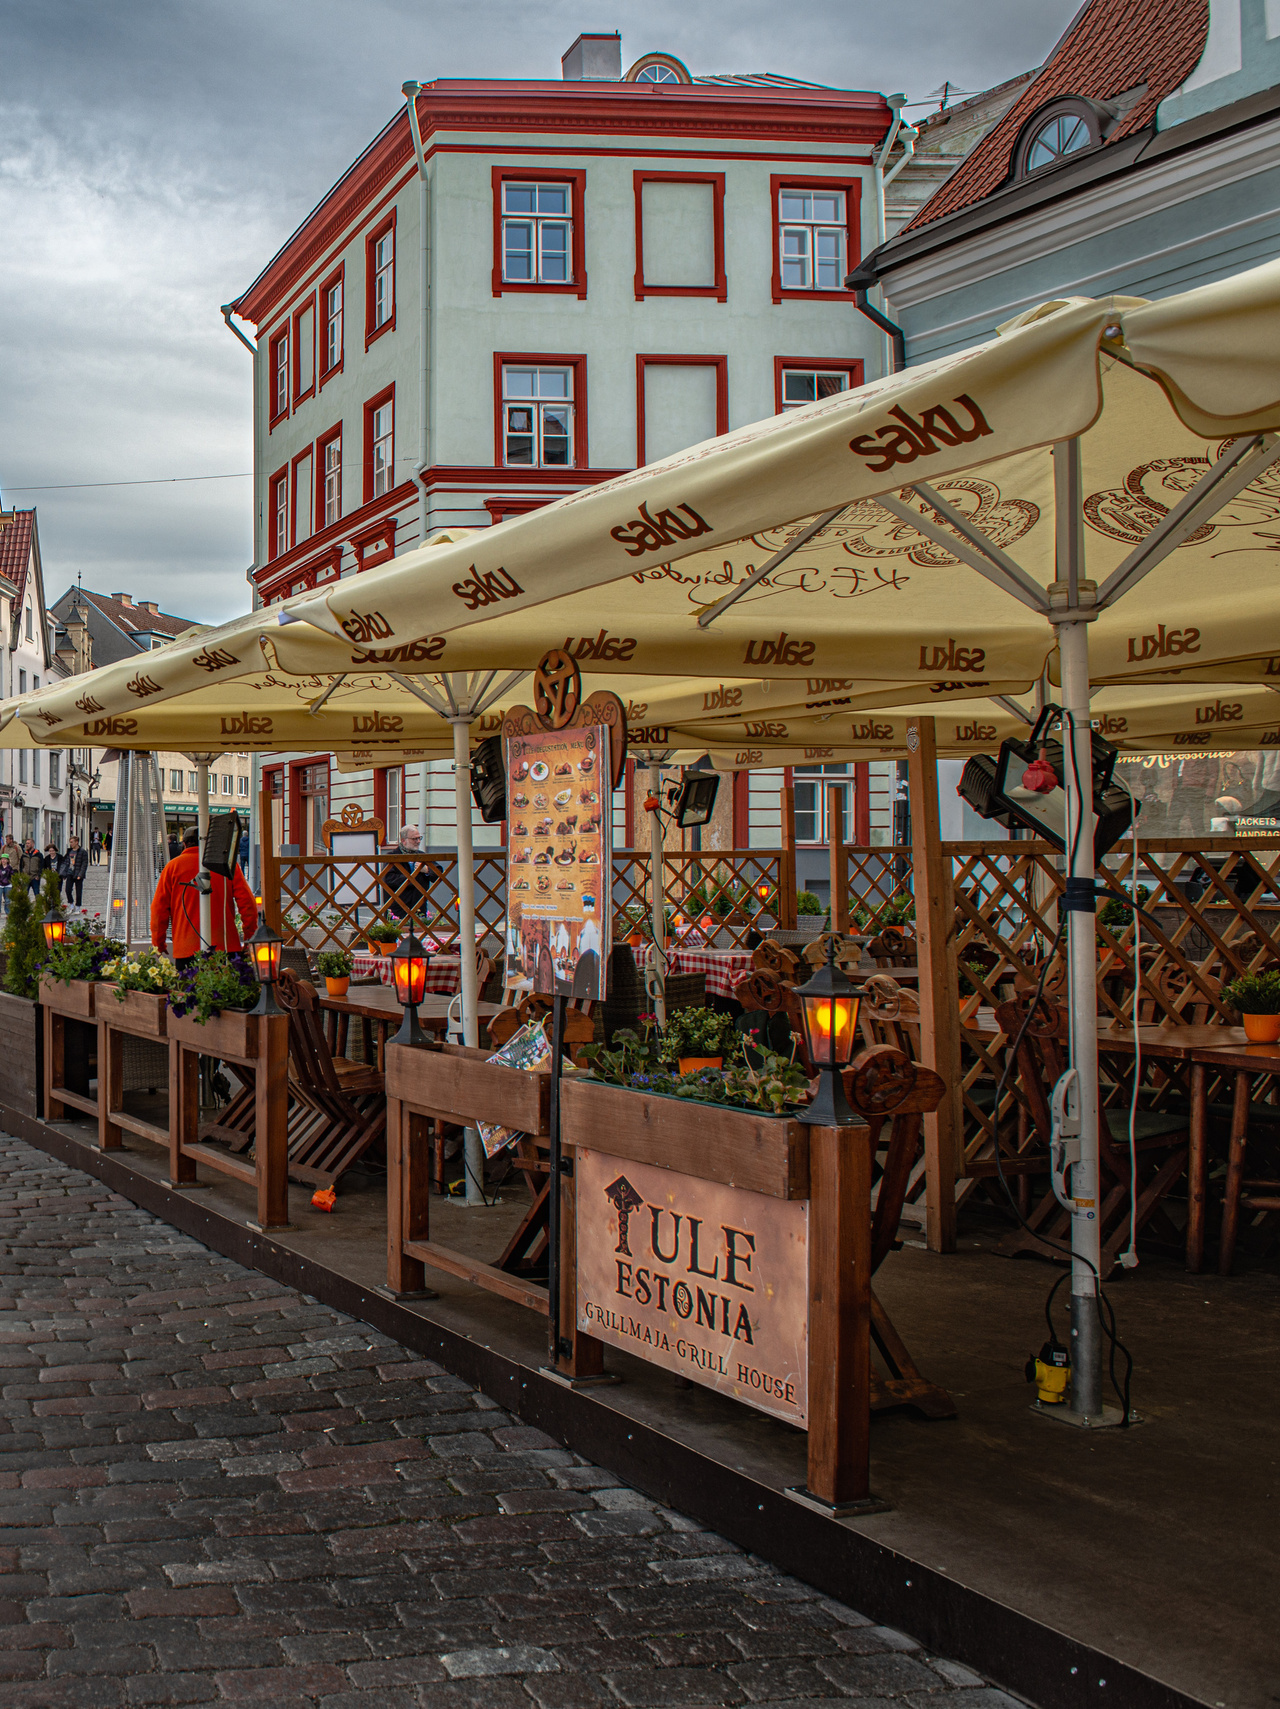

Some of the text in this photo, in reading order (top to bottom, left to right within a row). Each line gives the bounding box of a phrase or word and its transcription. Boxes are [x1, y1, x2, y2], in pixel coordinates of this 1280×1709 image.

[849, 394, 994, 473] saku
[610, 501, 713, 557] saku
[452, 564, 525, 610] saku
[342, 609, 395, 643] saku
[192, 646, 242, 673] saku
[126, 671, 164, 698] saku
[37, 707, 63, 727] saku
[75, 692, 106, 715] saku
[626, 727, 670, 744] saku
[1235, 817, 1277, 826] JACKETS
[604, 1174, 756, 1293] TULE
[615, 1258, 755, 1346] ESTONIA
[585, 1301, 798, 1405] GRILLMAJA-GRILL HOUSE
